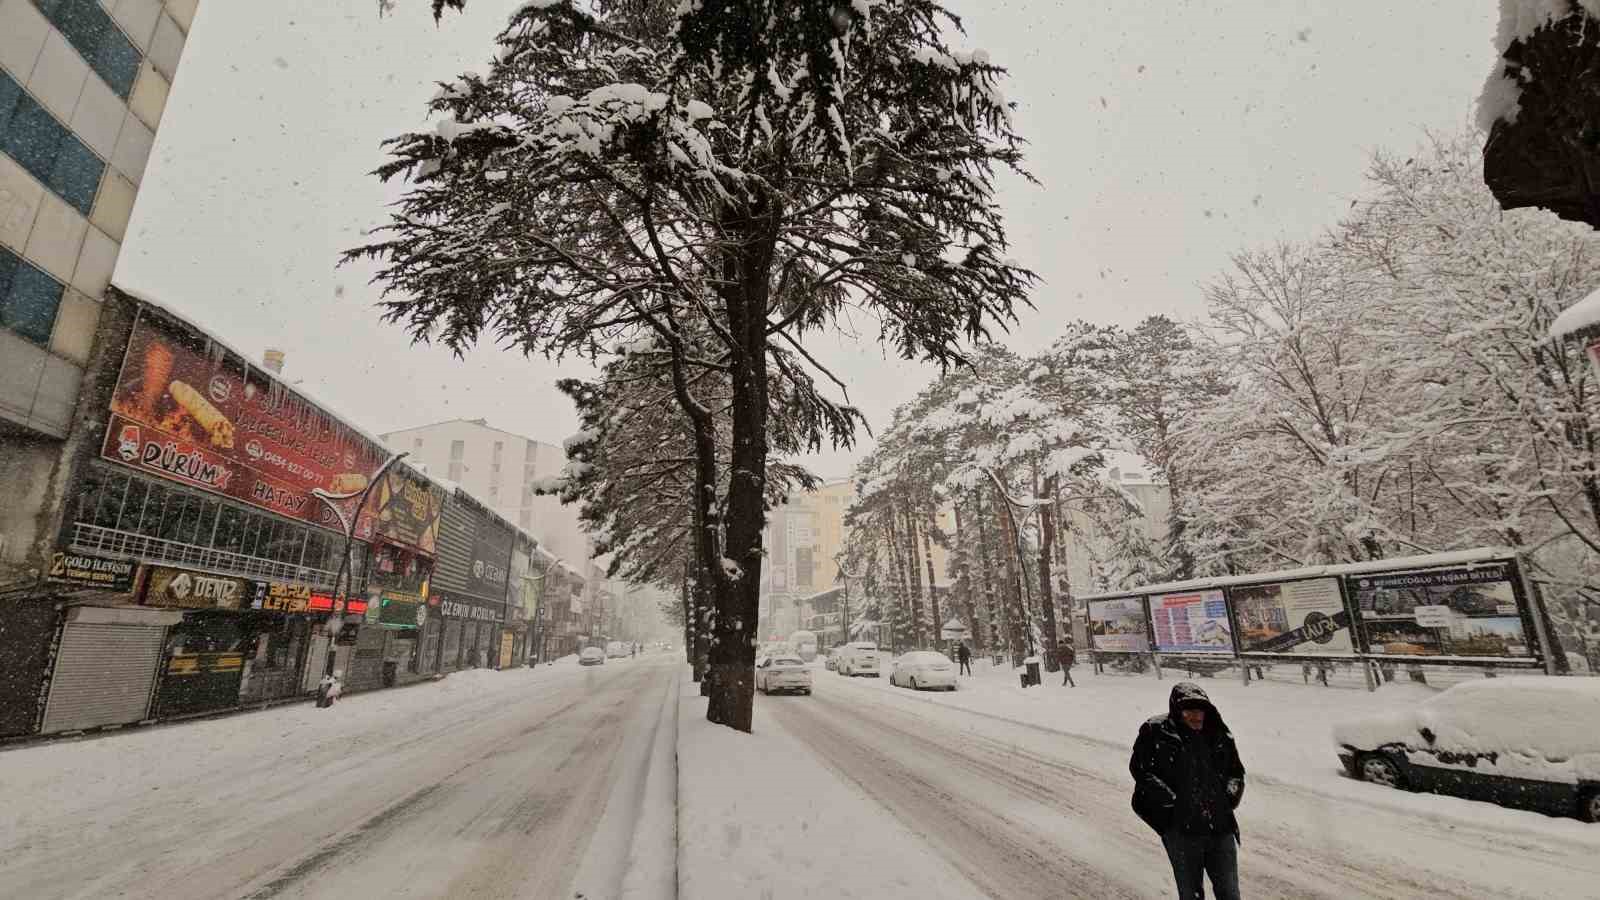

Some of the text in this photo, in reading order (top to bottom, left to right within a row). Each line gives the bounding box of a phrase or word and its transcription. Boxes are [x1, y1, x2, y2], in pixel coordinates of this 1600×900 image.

[142, 441, 217, 486] DÜRÜM
[252, 479, 306, 513] HATAY
[65, 556, 91, 569] GOLD
